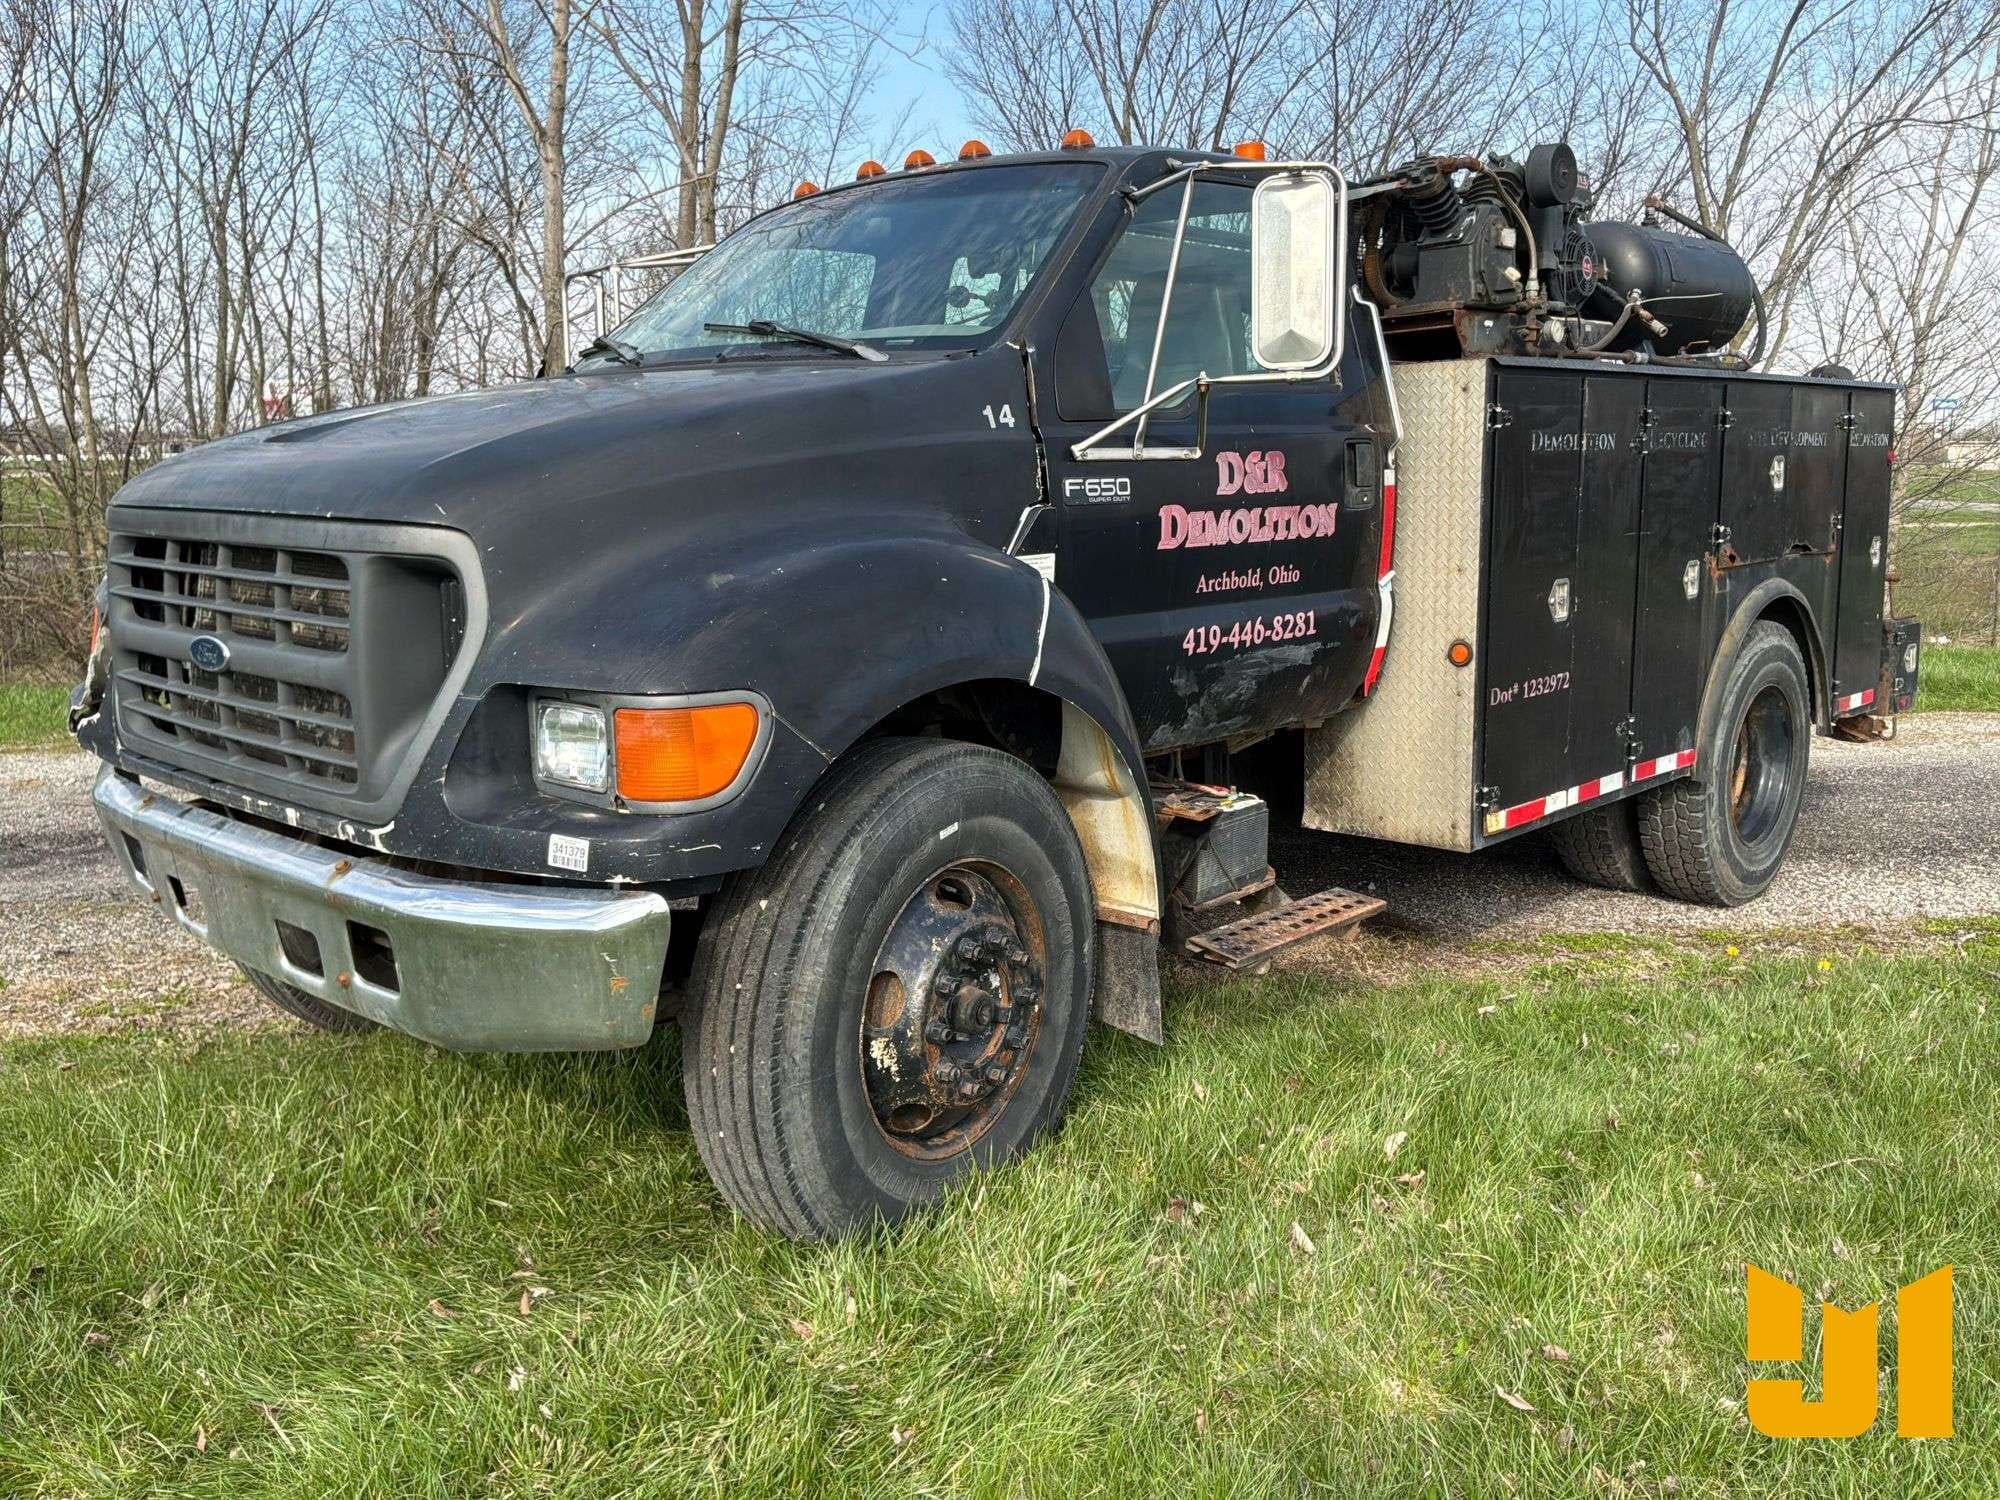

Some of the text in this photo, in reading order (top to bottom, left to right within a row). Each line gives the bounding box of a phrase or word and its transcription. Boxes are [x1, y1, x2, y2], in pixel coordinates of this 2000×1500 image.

[982, 404, 1016, 429] 14
[1216, 450, 1289, 496] D&R
[1157, 502, 1339, 551] DEMOLITION
[1195, 563, 1301, 594] Archbold, Ohio
[1182, 609, 1318, 657] 419-446-8281
[1489, 671, 1570, 707] Dot# 1232972
[551, 842, 587, 859] 341379
